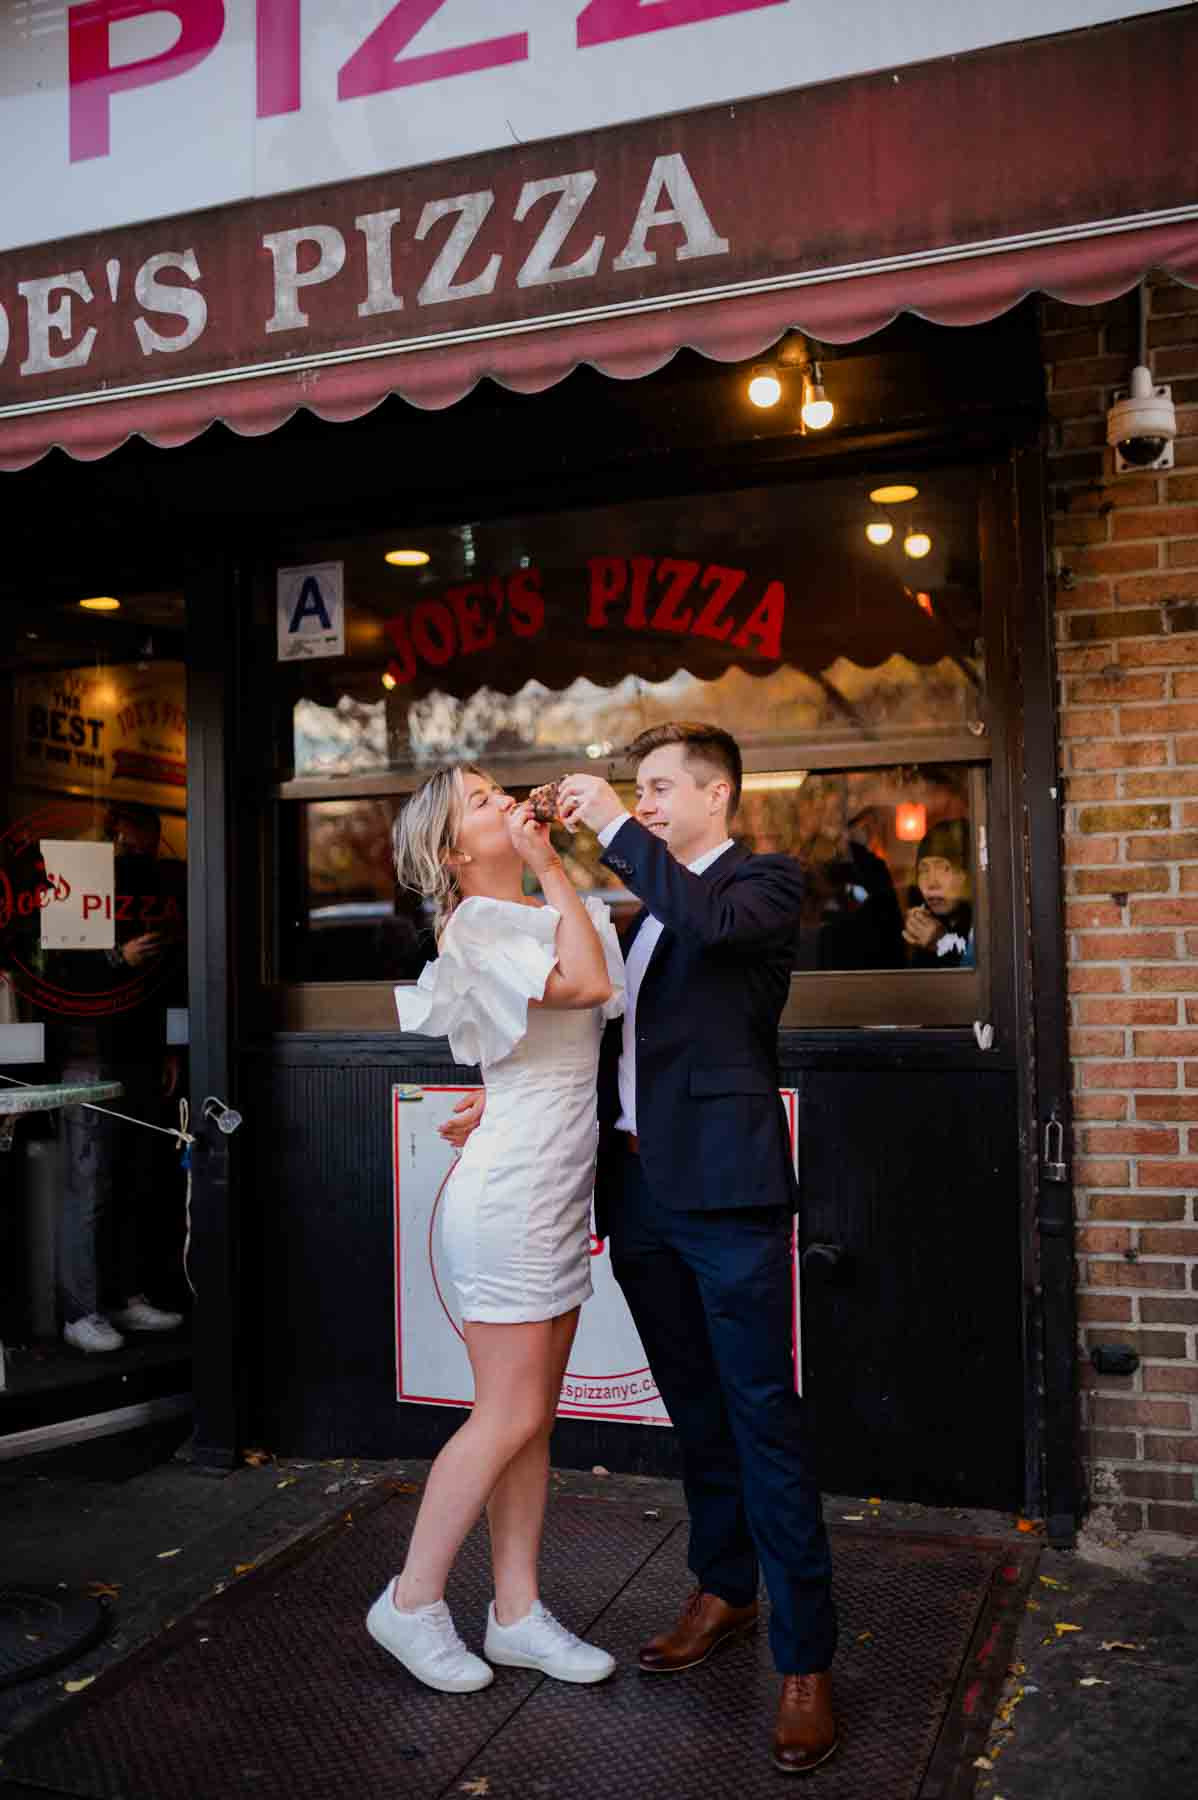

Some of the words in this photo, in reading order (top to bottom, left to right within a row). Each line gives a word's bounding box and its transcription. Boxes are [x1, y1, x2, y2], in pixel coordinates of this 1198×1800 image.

[262, 152, 729, 334] PIZZA
[288, 576, 332, 633] A
[383, 567, 545, 685] JOE'S
[586, 556, 786, 660] PIZZA
[29, 706, 104, 749] BEST
